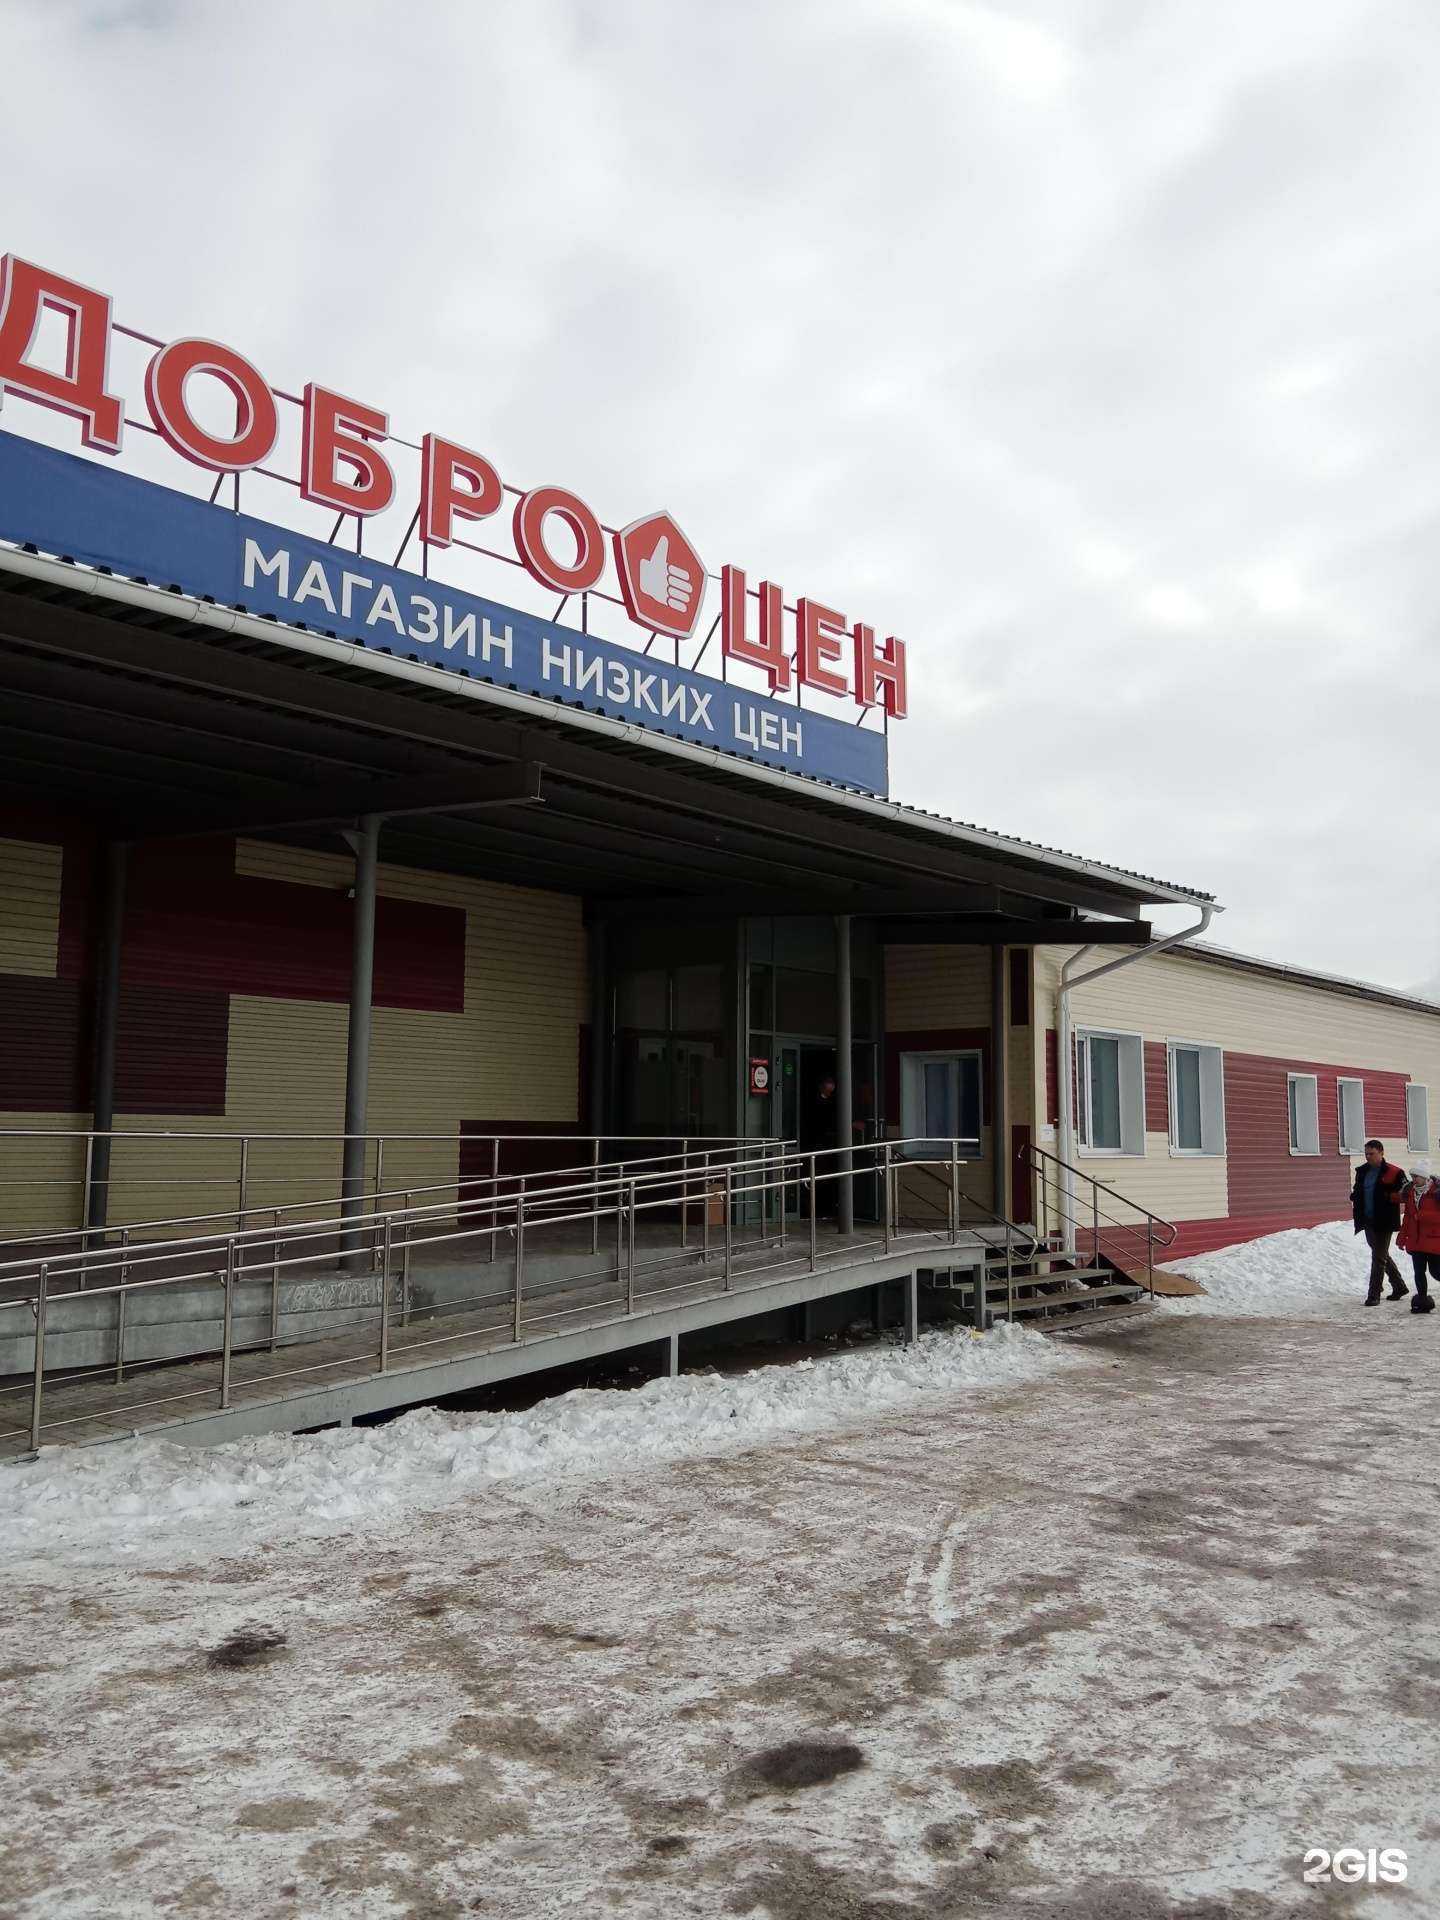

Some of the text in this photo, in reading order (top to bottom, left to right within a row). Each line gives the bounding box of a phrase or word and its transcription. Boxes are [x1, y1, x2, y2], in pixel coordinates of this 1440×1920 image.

[243, 538, 803, 757] МАГАЗИН НИЗКИХ ЦЕН
